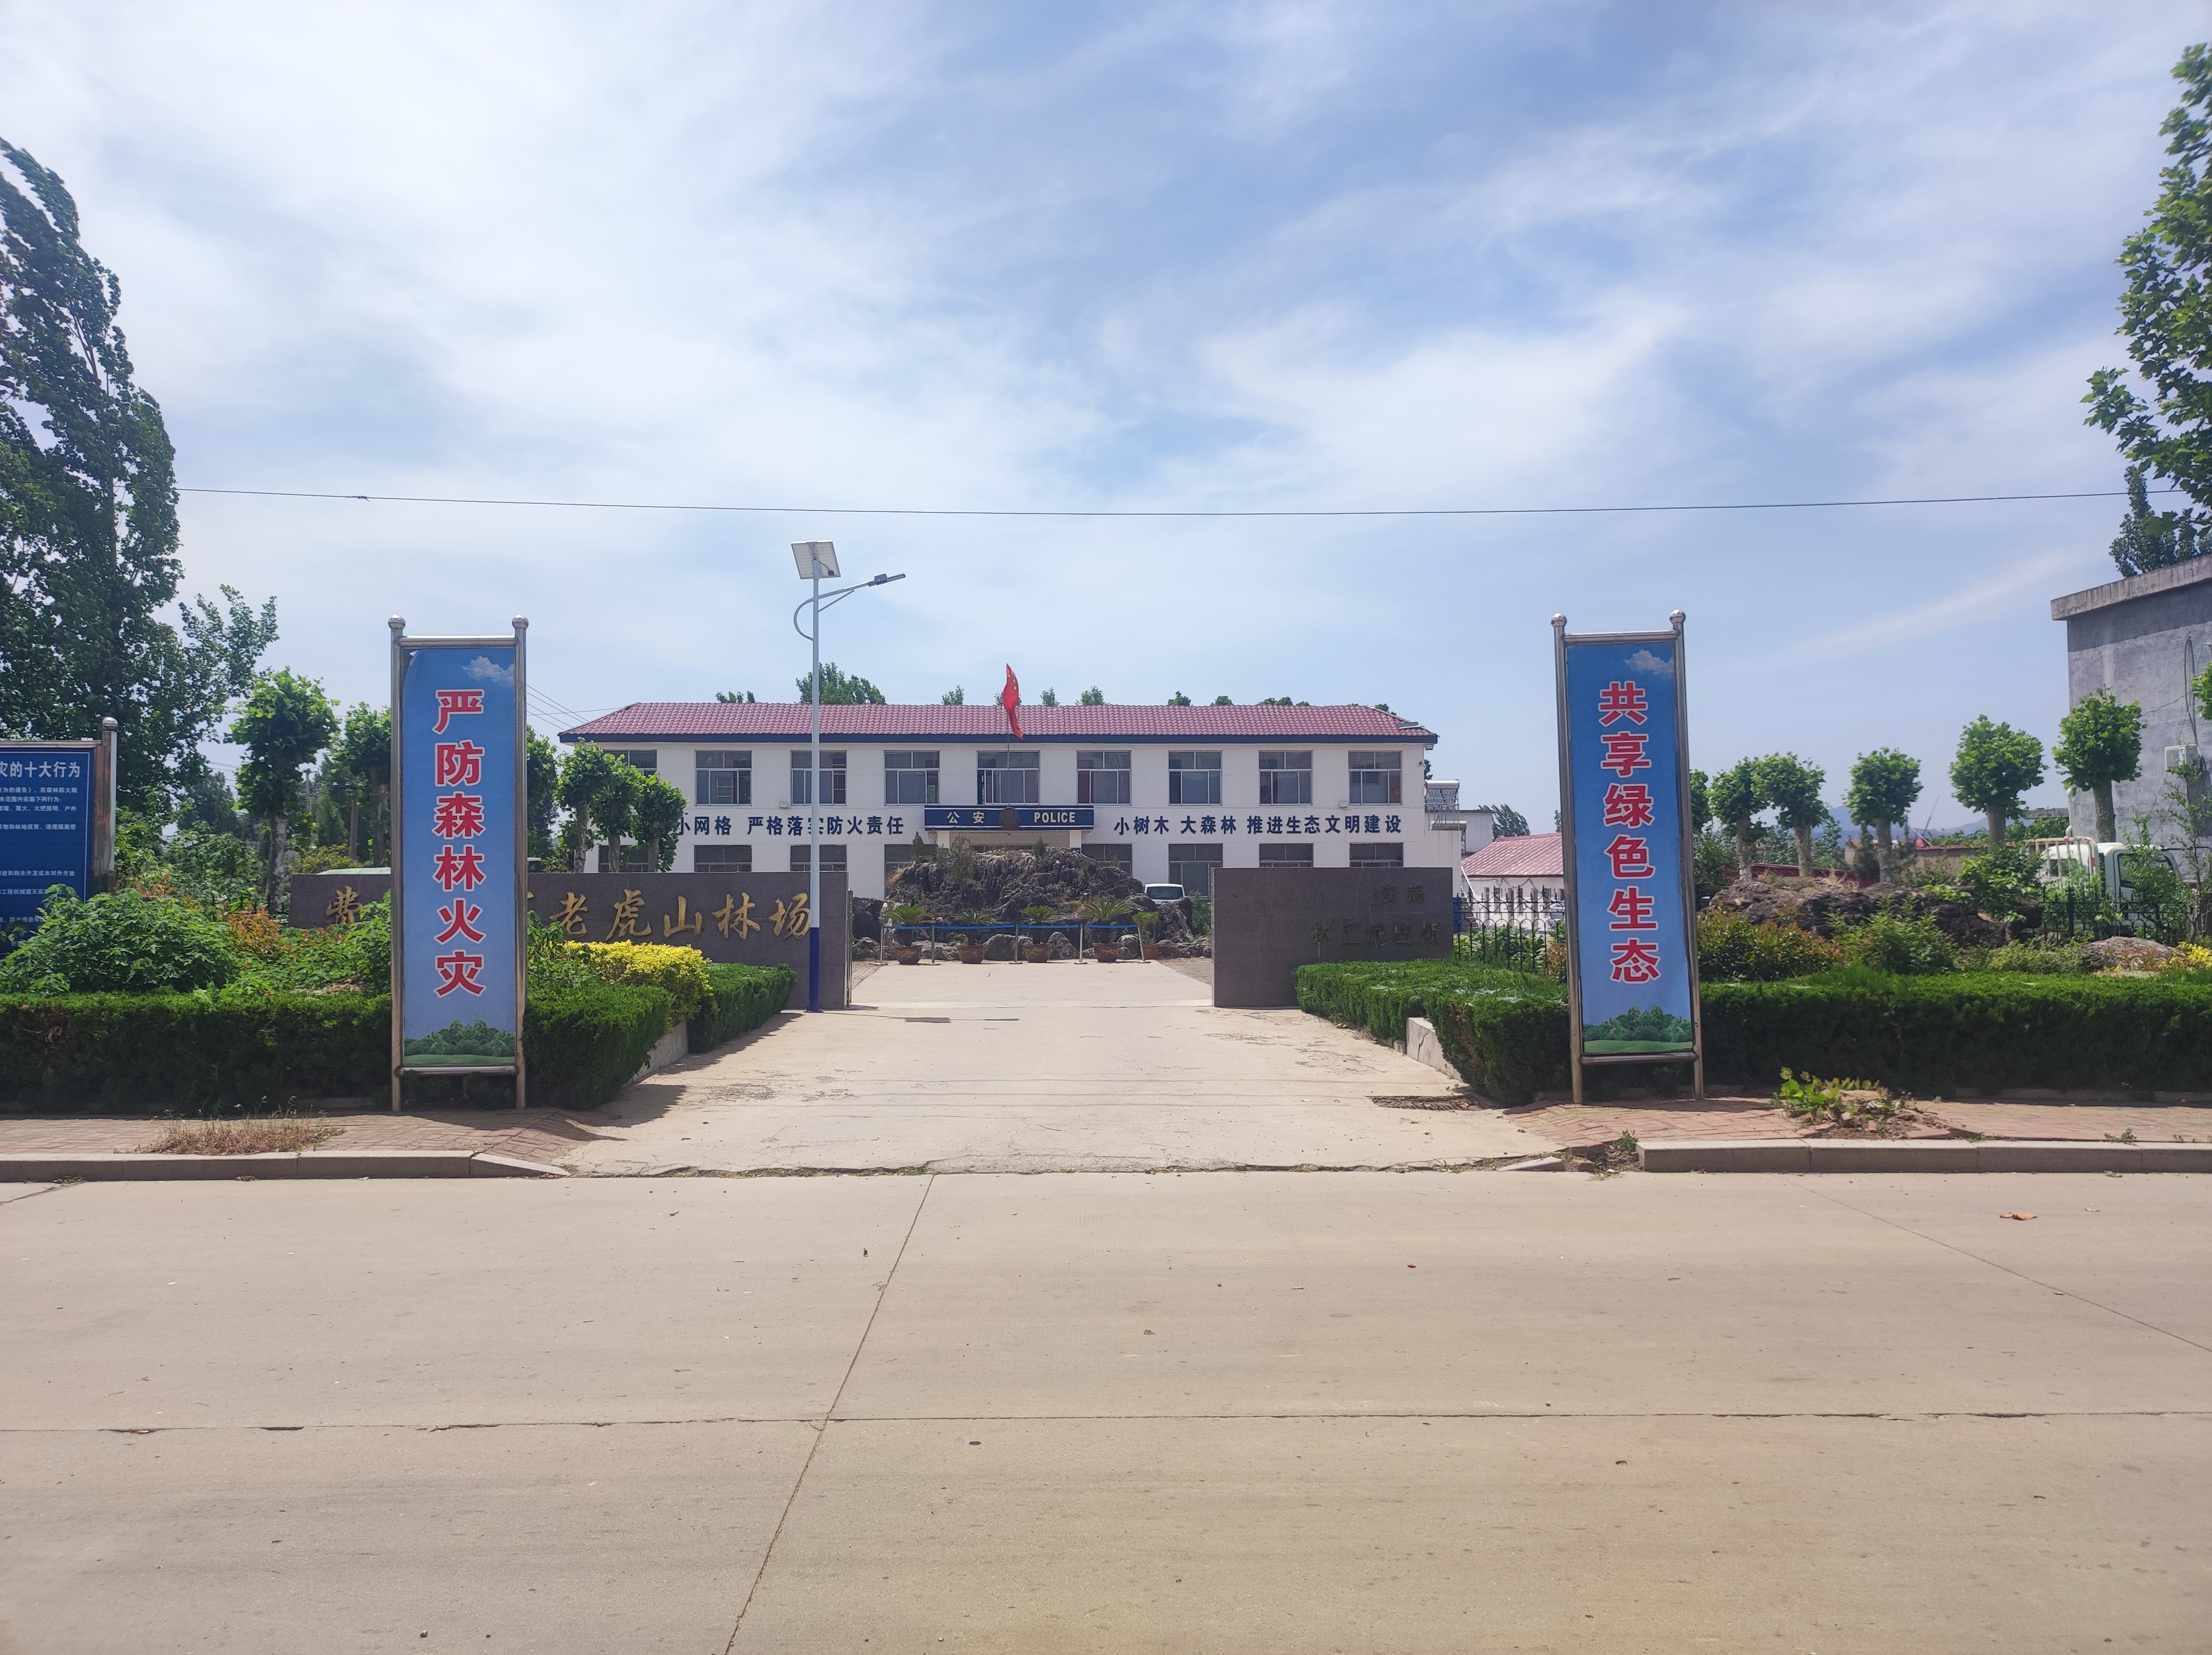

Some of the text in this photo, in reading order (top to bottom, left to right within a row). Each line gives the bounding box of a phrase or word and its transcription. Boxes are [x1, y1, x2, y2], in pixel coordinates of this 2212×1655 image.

[677, 816, 732, 835] 小网格
[947, 811, 1076, 824] 公安 POLICE
[1114, 814, 1402, 836] 小树木 大森林 推进生态文明建设
[1598, 680, 1661, 984] 共享绿色生态
[432, 688, 487, 998] 严防森林火灾
[549, 889, 810, 940] 老虎山林场
